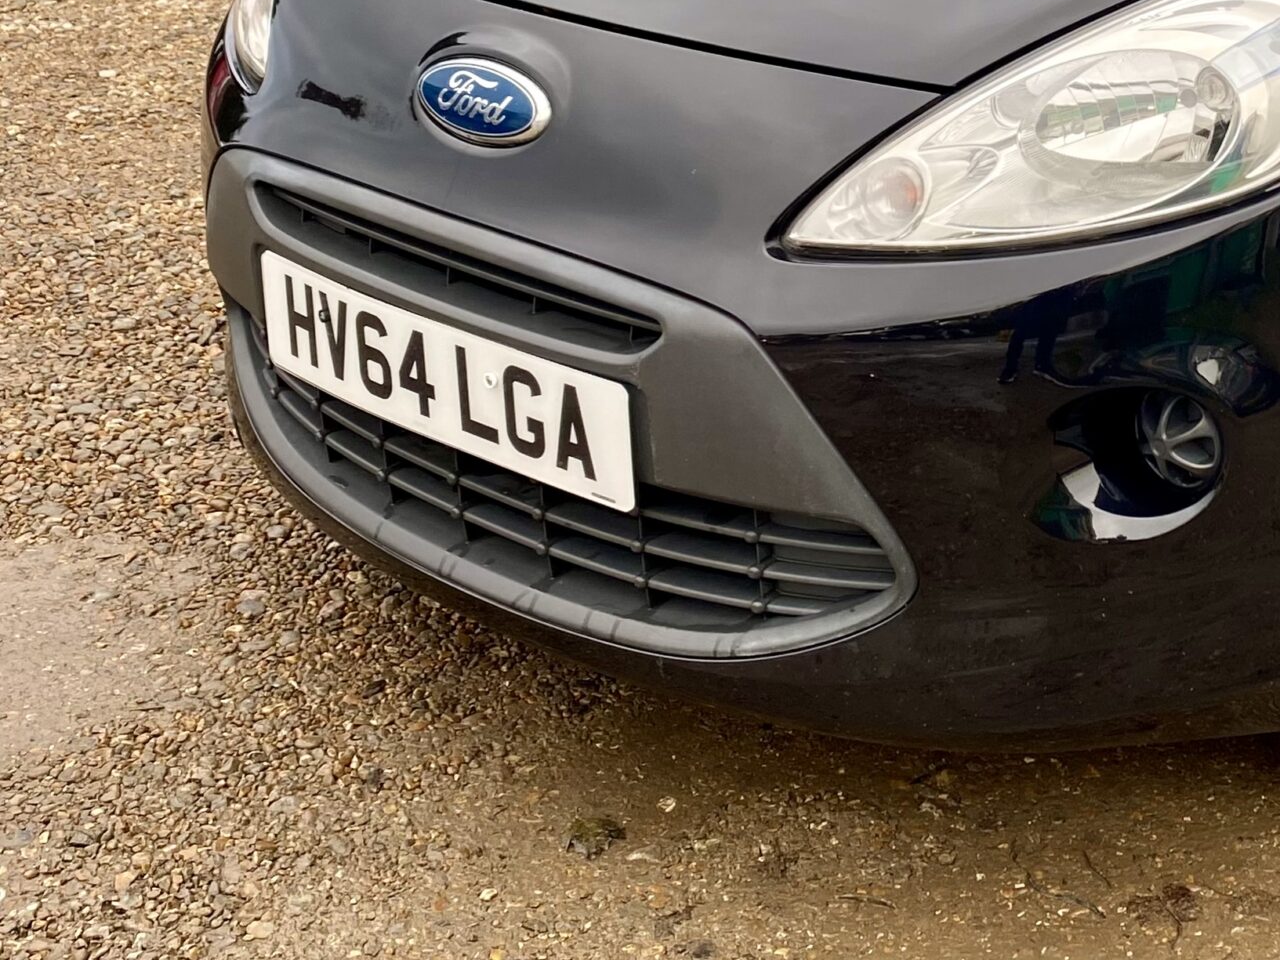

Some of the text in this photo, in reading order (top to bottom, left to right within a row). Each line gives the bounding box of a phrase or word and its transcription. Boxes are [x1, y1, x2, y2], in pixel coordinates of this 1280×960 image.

[437, 70, 514, 126] Ford
[284, 274, 597, 481] HV64 LGA
